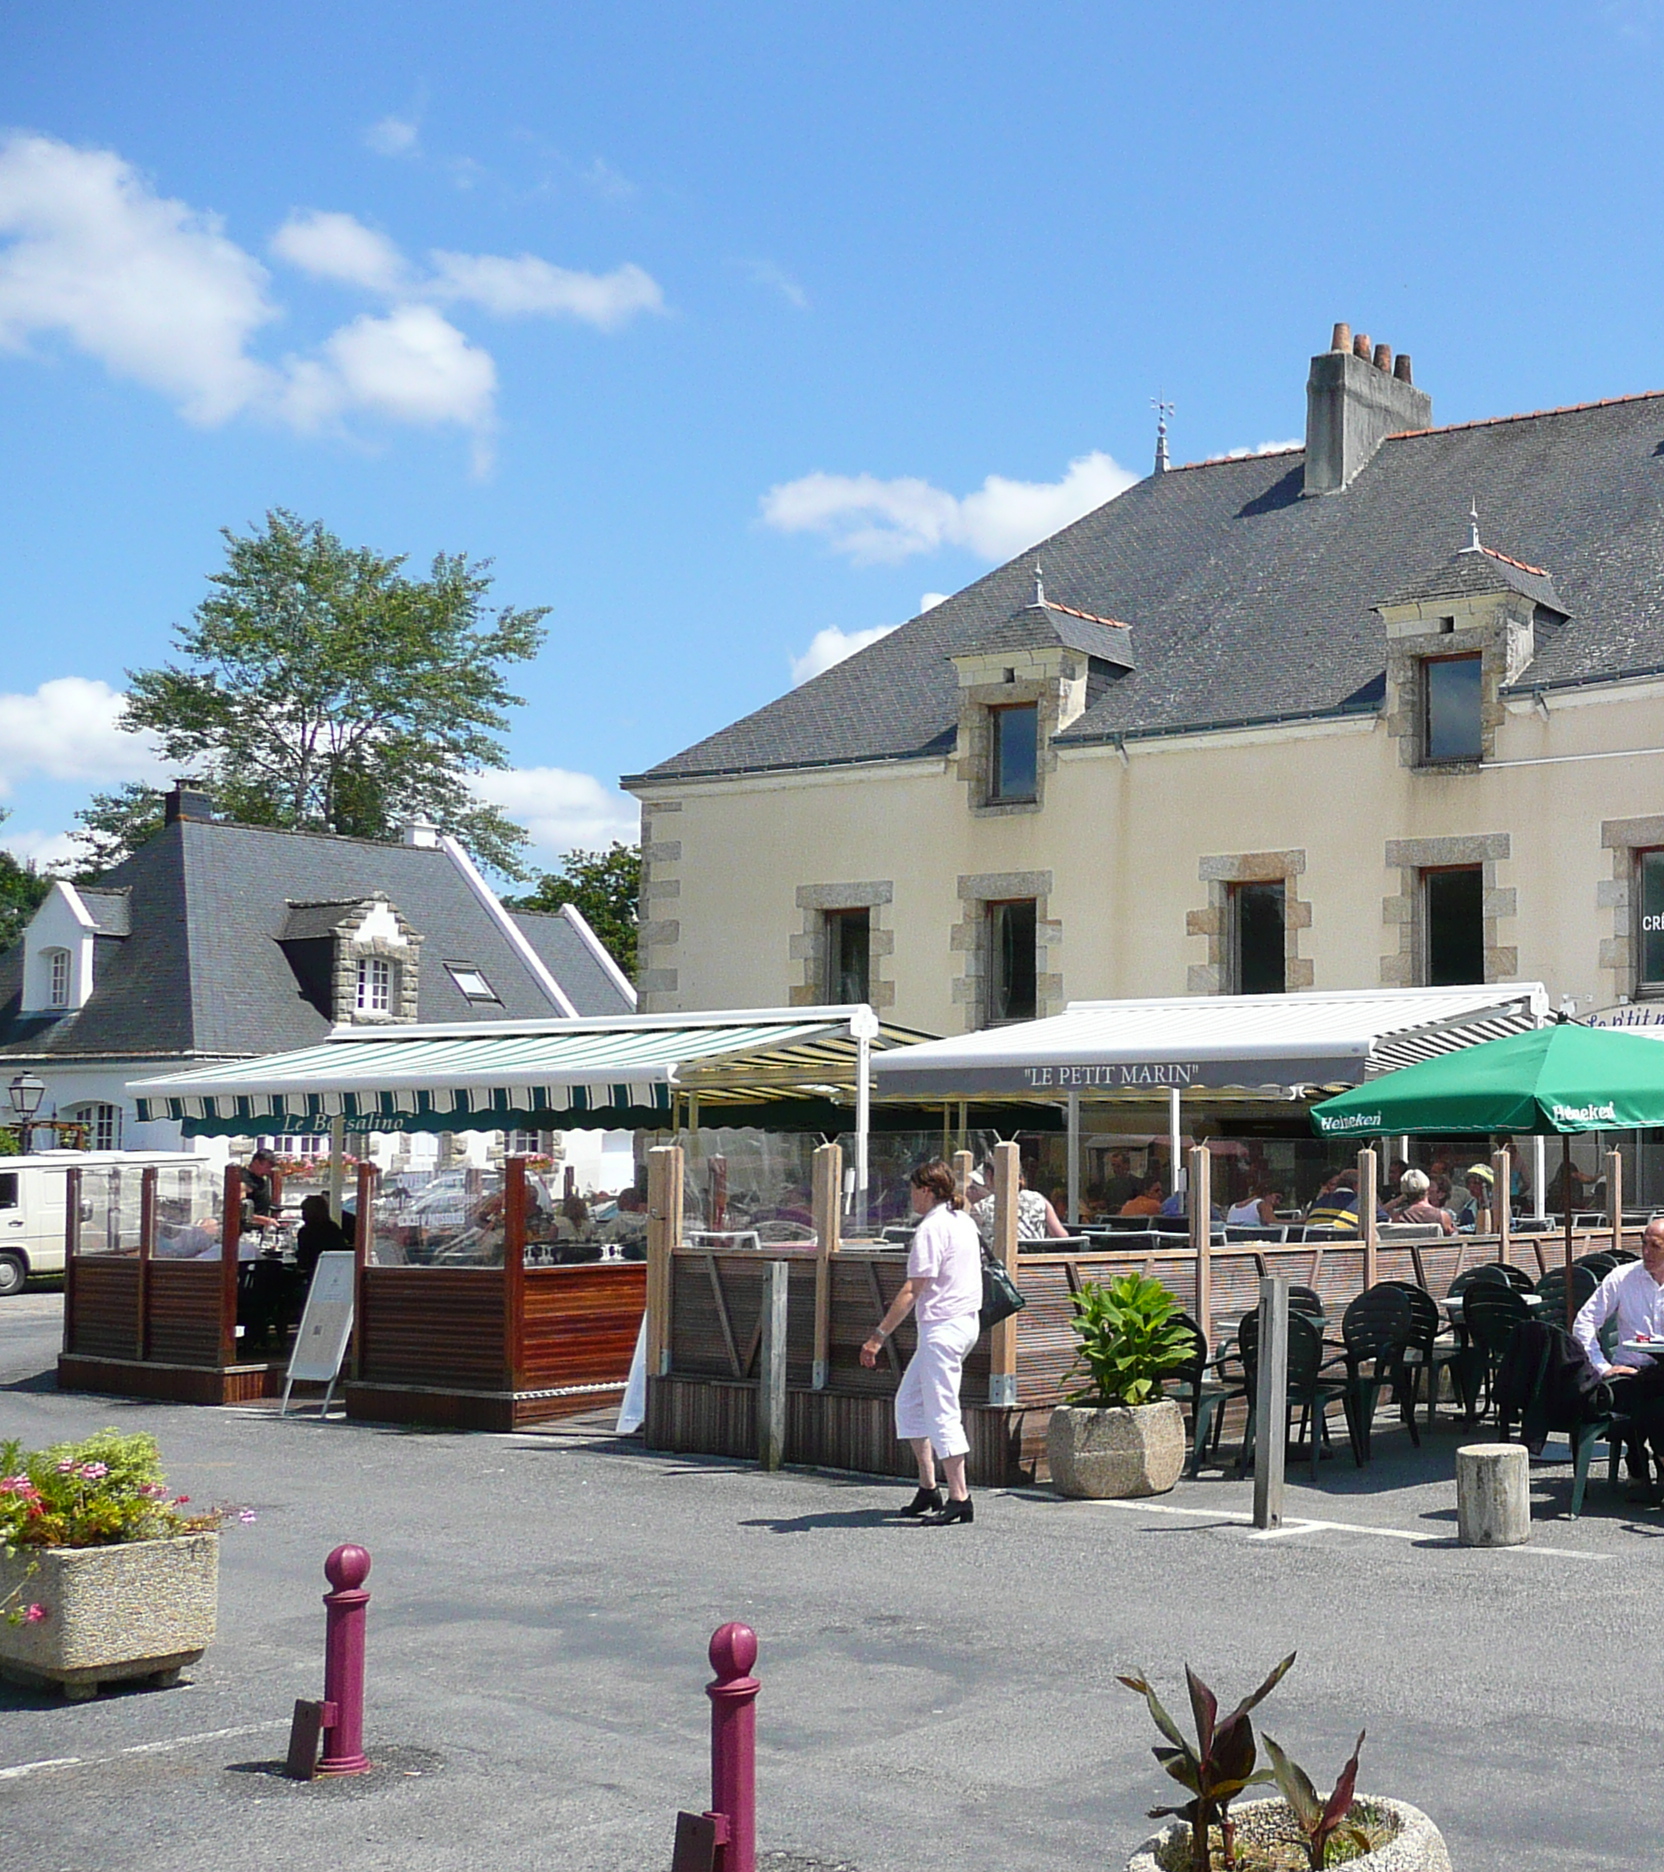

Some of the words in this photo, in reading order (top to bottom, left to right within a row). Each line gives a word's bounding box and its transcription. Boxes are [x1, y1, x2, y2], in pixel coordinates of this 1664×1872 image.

[1058, 1066, 1115, 1085] PETIT
[281, 1114, 305, 1132] Le
[312, 1112, 404, 1132] Bosalino
